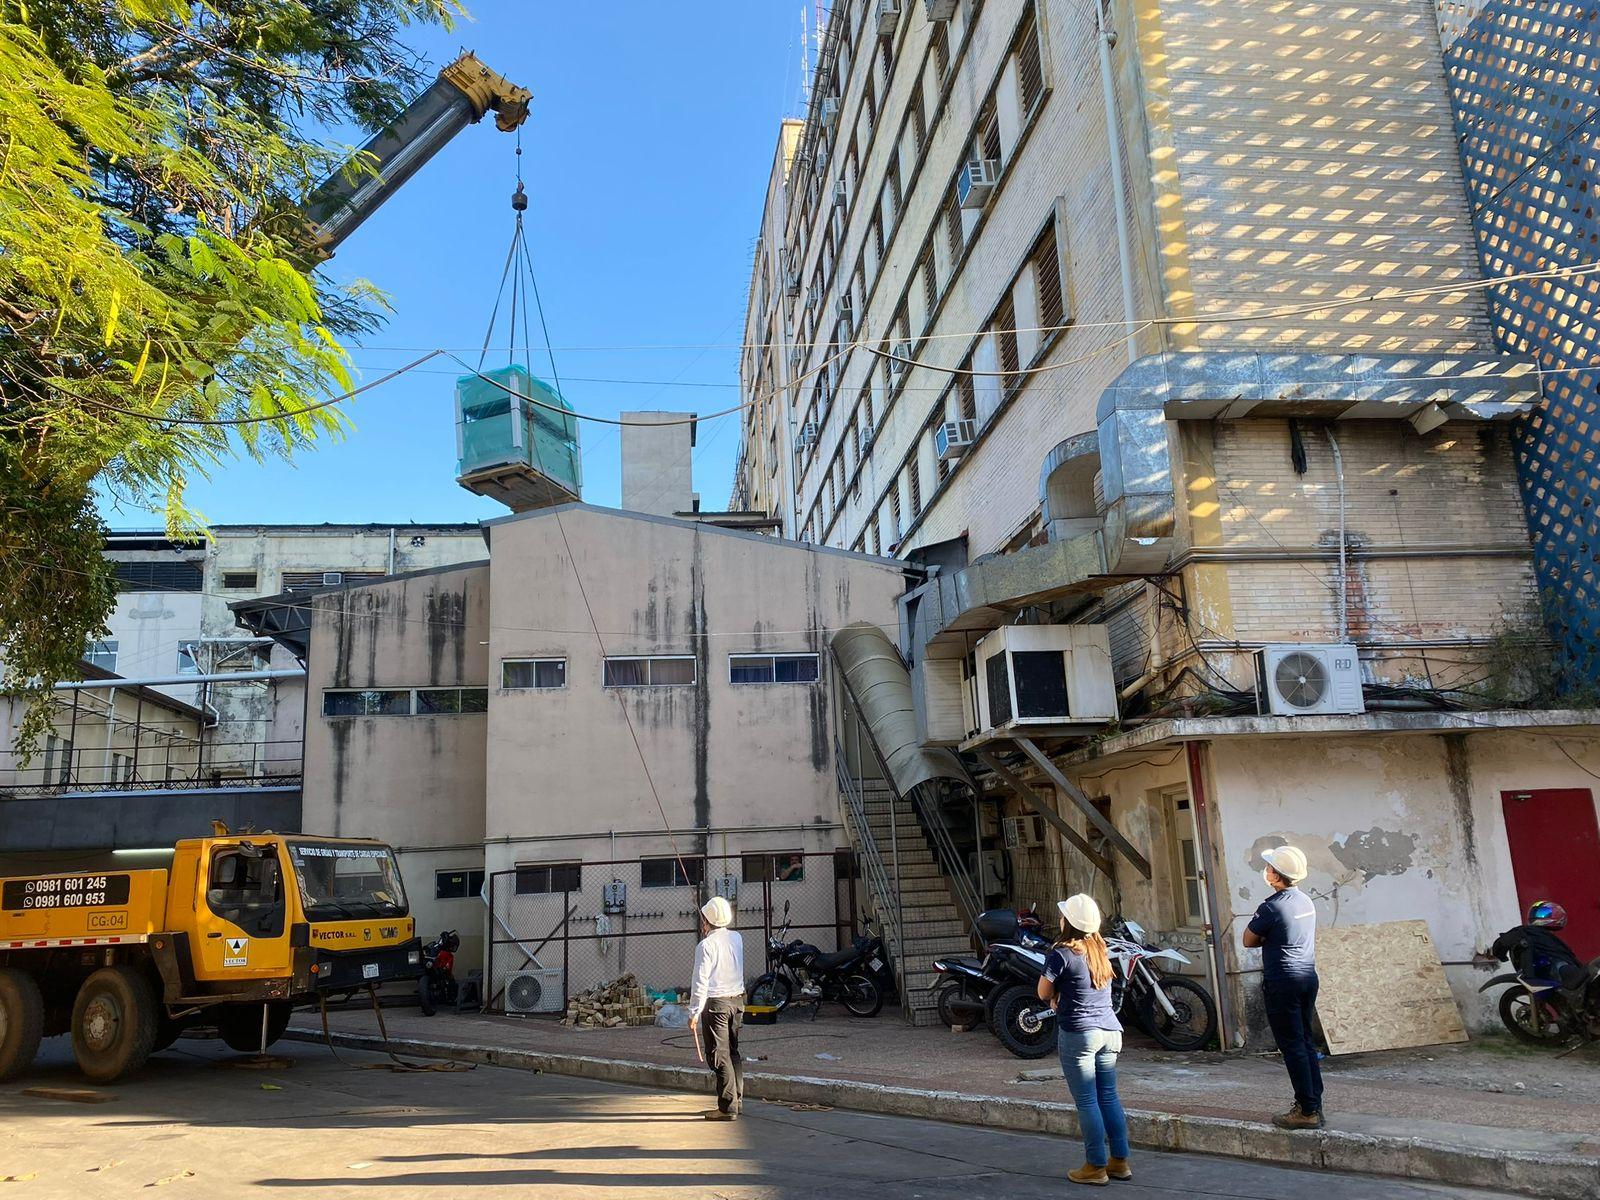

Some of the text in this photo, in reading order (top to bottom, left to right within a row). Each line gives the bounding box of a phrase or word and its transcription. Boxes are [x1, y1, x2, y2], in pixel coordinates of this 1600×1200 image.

[36, 877, 107, 892] 0981 601 245
[35, 892, 105, 908] 0981 600 953
[91, 915, 124, 927] CG:04
[319, 930, 344, 940] VECTOR
